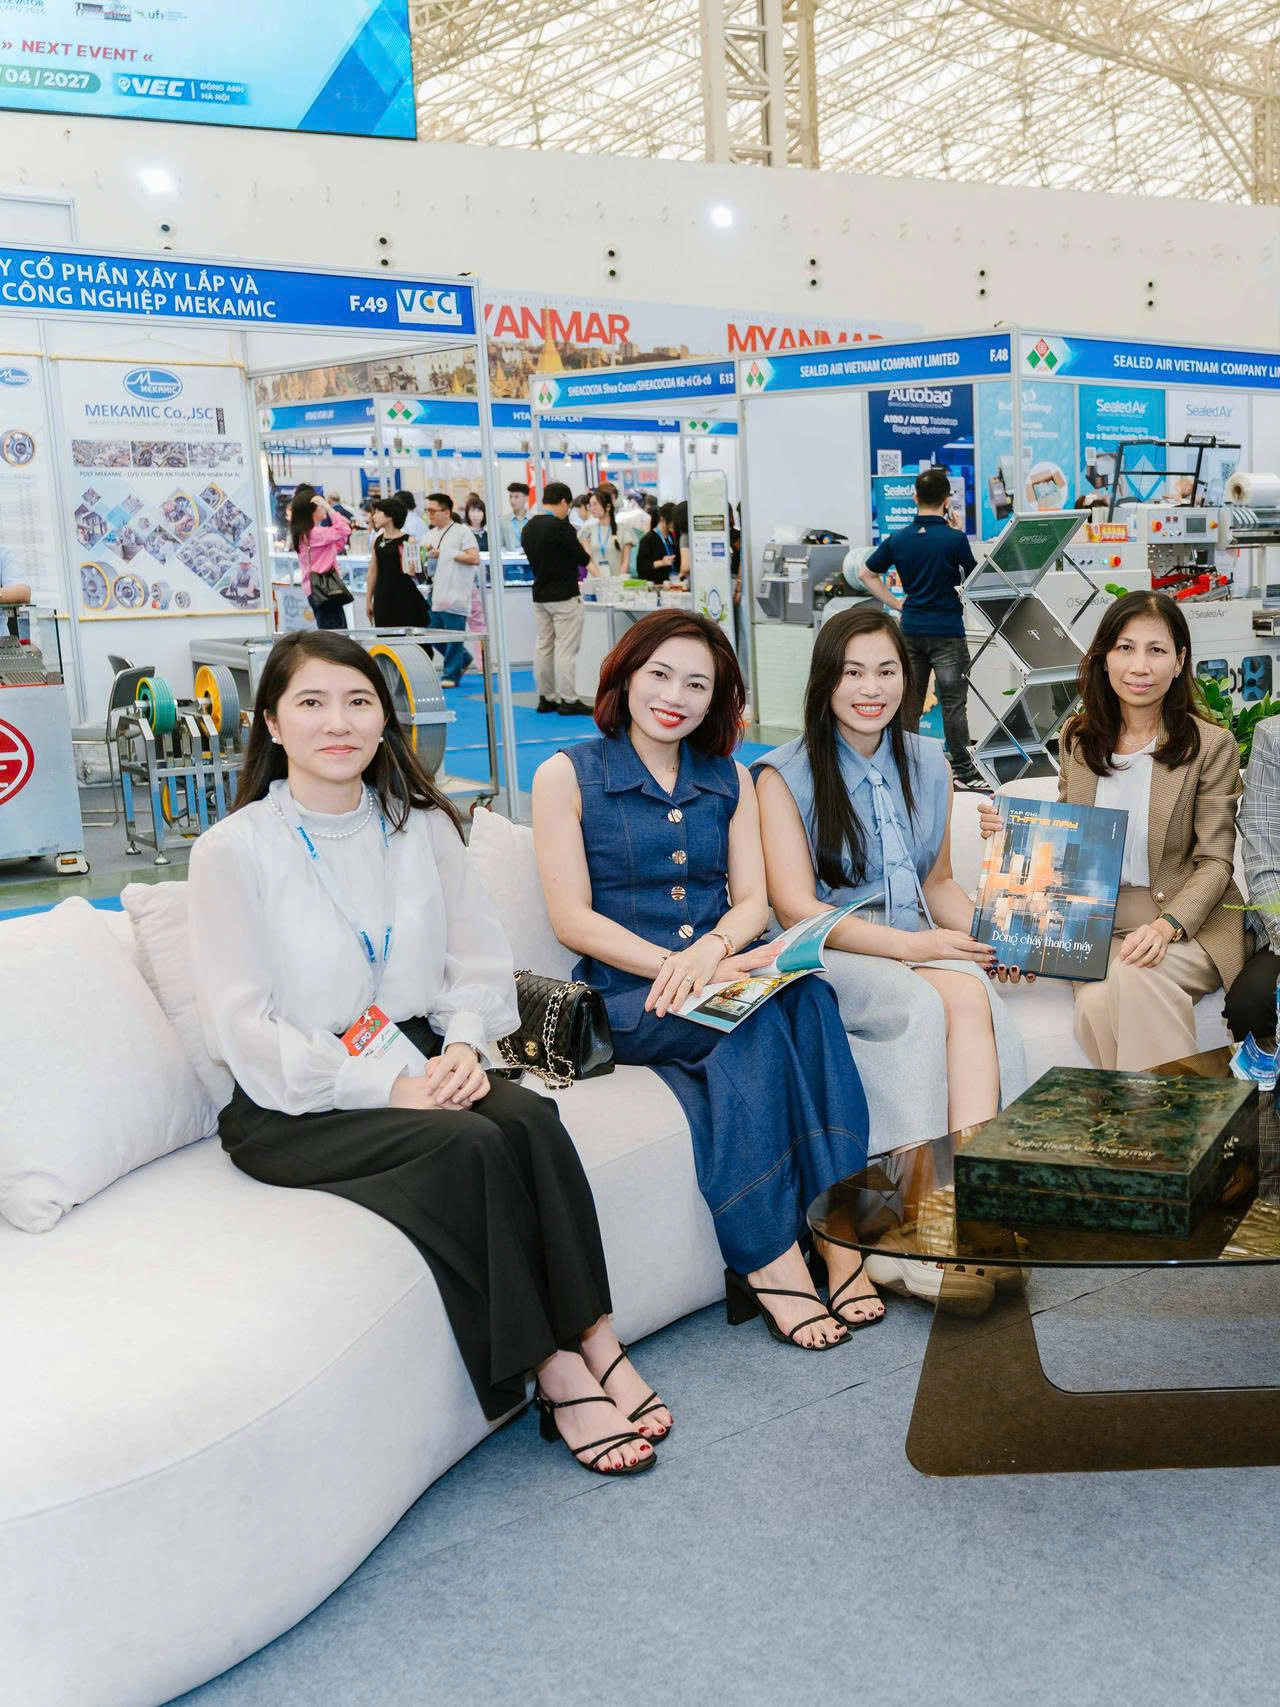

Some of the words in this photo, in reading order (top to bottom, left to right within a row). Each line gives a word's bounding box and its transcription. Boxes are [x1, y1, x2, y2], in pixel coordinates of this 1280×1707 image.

[21, 39, 73, 56] NEXT
[77, 44, 138, 62] EVENT
[131, 77, 185, 98] VEC
[20, 256, 54, 280] CỔ
[62, 262, 128, 287] PHẦN
[136, 267, 178, 289] XÂY
[185, 268, 225, 294] LẮP
[231, 274, 259, 295] VÀ
[2, 281, 73, 305] CÔNG
[81, 288, 167, 315] NGHIỆP
[175, 295, 277, 319] MEKAMIC
[349, 295, 388, 314] F.49
[484, 302, 630, 346] ANMAR
[800, 362, 829, 378] SEALED
[830, 361, 843, 376] AIR
[843, 357, 881, 375] VIETNAM
[881, 355, 923, 372] COMPANY
[924, 351, 960, 368] LIMITED
[989, 348, 1009, 363] F.48
[1113, 354, 1154, 370] SEALED
[1155, 357, 1173, 371] AIR
[1174, 358, 1220, 375] VIETNAM
[1221, 361, 1268, 378] COMPANY
[140, 384, 178, 395] MEKAMIC
[719, 373, 734, 385] F.13
[887, 387, 952, 406] Autobag
[85, 404, 160, 419] MEKAMIC
[163, 406, 213, 421] Co.,JSC
[892, 424, 921, 436] Bagging
[921, 425, 951, 435] Systems
[992, 929, 1018, 946] Dòng
[1020, 935, 1043, 950] chảy
[1044, 935, 1072, 952] thang
[1073, 940, 1094, 953] máy
